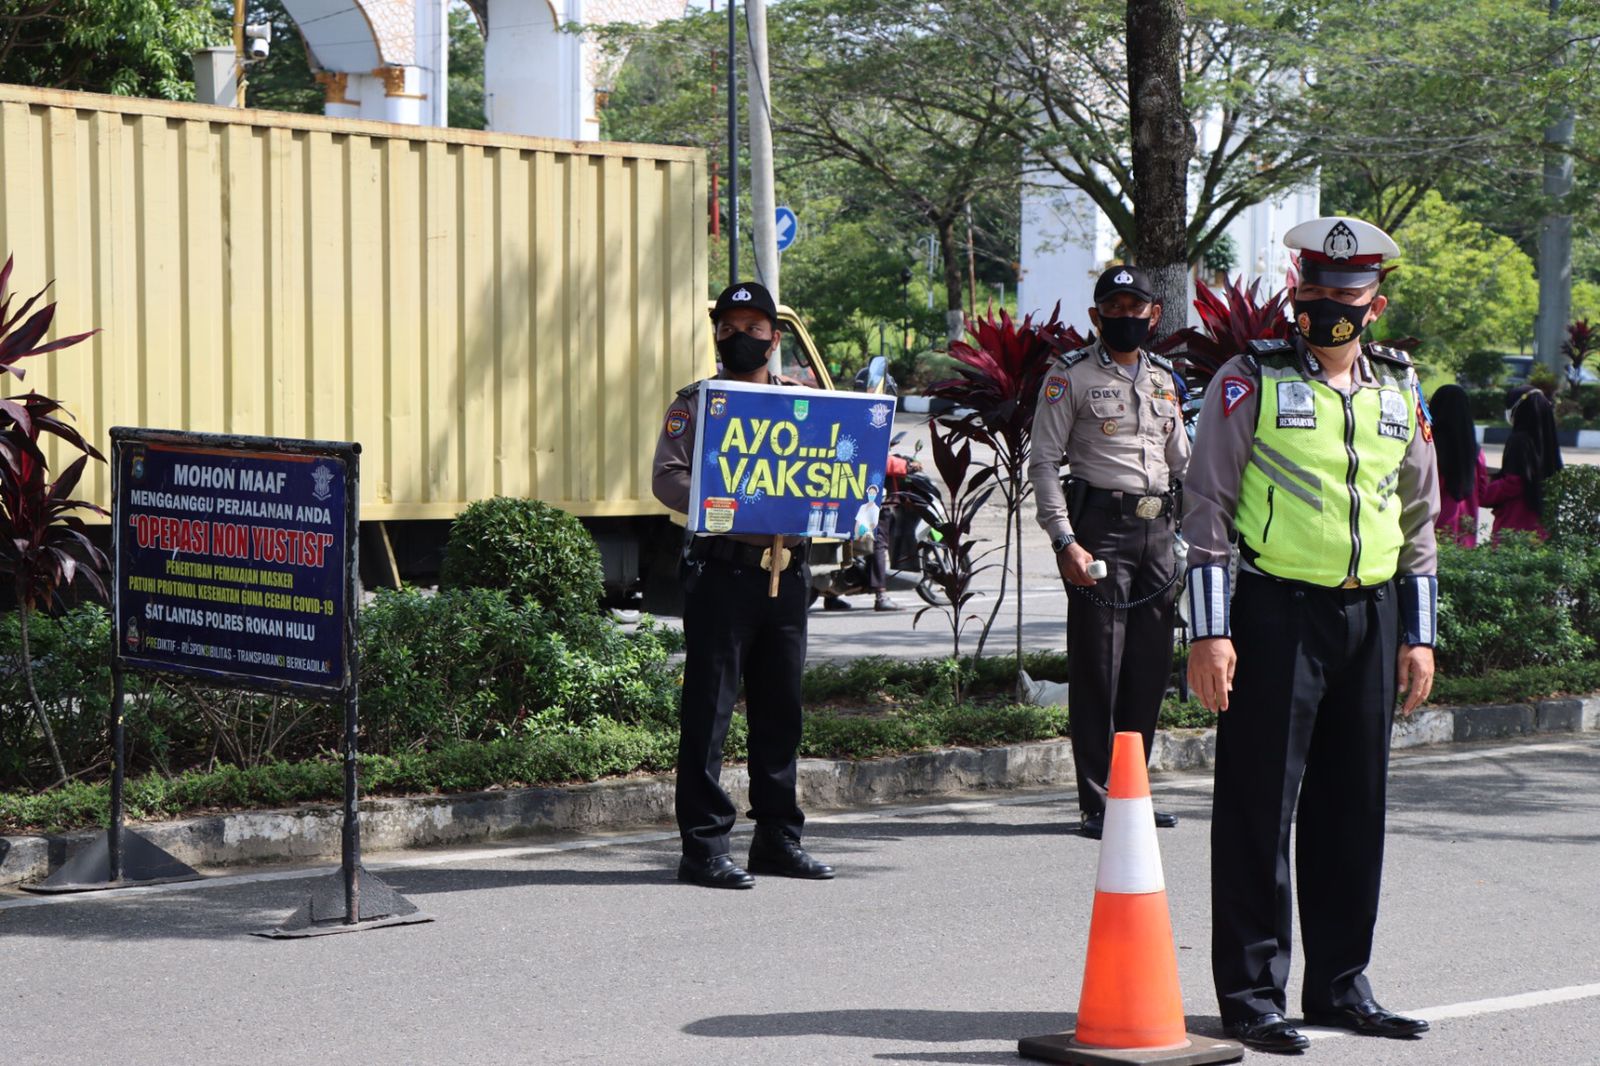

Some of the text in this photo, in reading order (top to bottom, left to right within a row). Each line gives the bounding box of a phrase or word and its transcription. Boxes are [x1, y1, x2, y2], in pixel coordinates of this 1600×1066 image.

[1380, 423, 1408, 440] POLIS
[174, 464, 287, 494] MOHON MAAF
[718, 457, 867, 499] VAKSIN
[131, 490, 332, 524] MENGGANGGU PERJALANAN ANDA
[213, 522, 249, 559] NON
[166, 560, 293, 589] PENERTIBAN PEMAKAIAN MASKER
[129, 576, 334, 616] PATUHI PROTOKOL KESEHATAN GUNA CEGAH COVID-19
[145, 603, 315, 641] SAT LANTAS POLRES ROKAN HULU
[146, 636, 176, 650] PREDIKTIF
[237, 649, 285, 667] TRANSPARANSI
